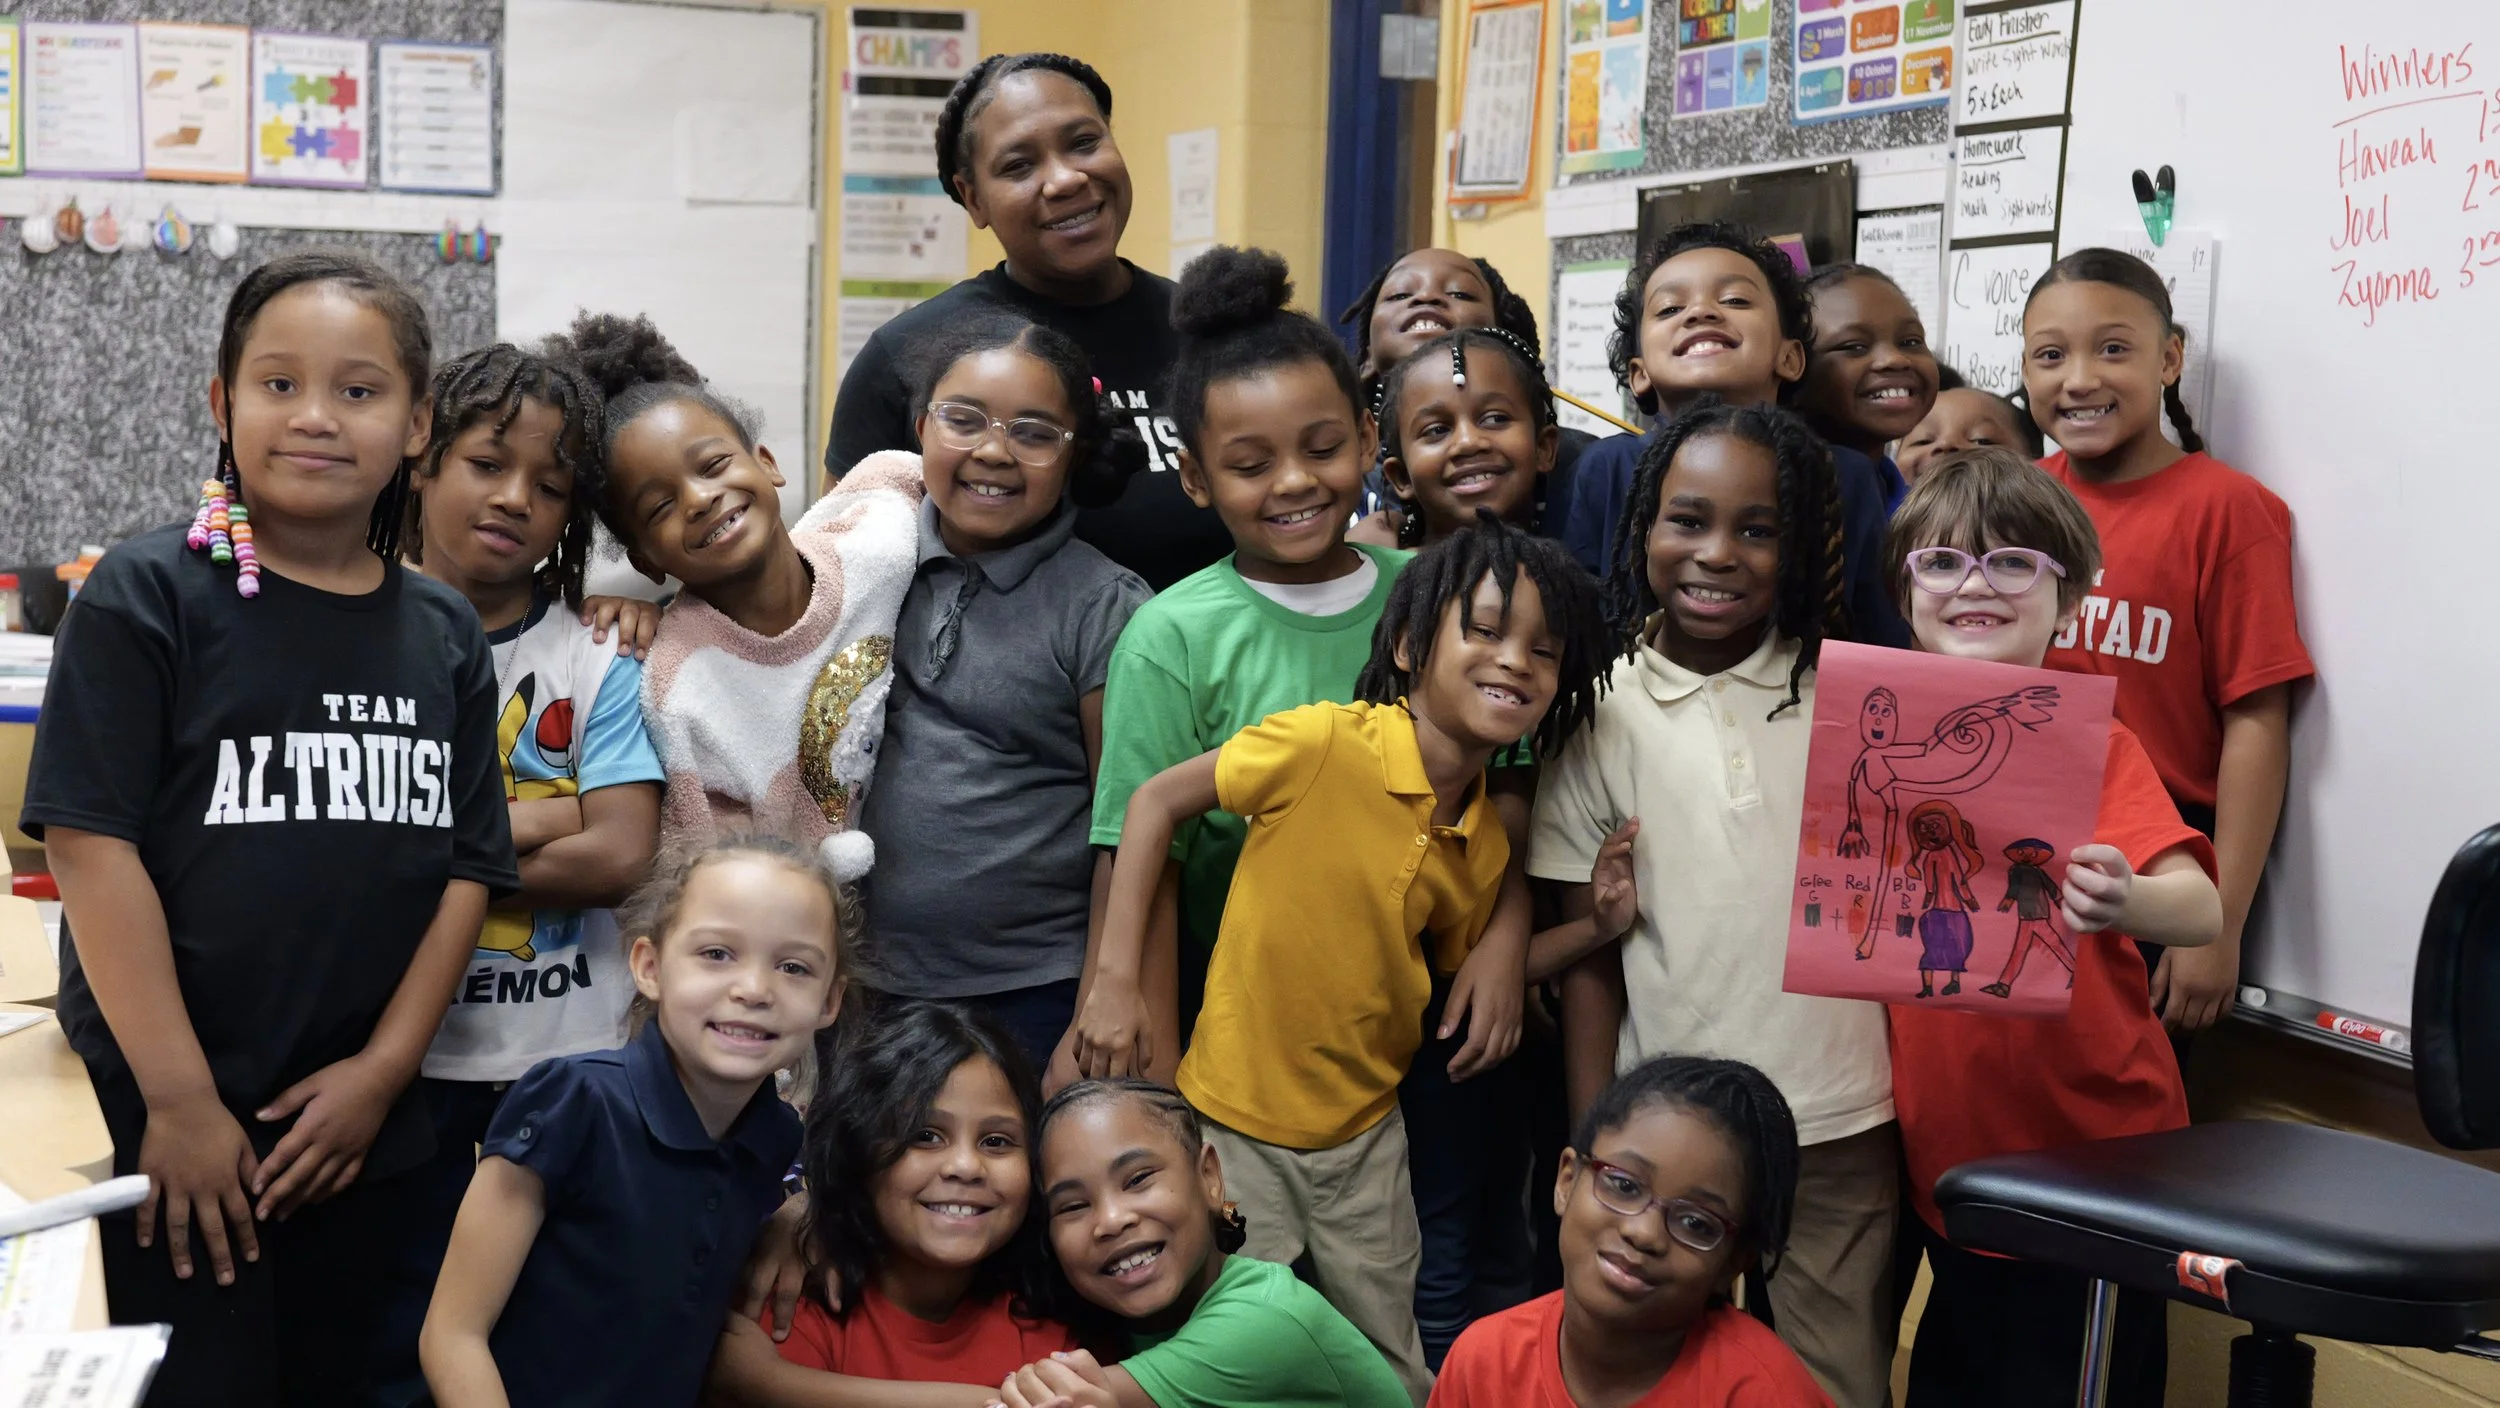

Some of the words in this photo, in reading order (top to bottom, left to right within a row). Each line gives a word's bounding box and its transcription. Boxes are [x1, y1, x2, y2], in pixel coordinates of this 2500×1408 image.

[1680, 13, 1735, 44] WEATHER
[1823, 24, 1844, 39] March
[1856, 33, 1894, 49] September
[1915, 22, 1953, 37] November
[857, 34, 961, 69] CHAMPS
[1906, 56, 1943, 70] December
[1865, 63, 1894, 77] October
[2340, 42, 2473, 102] Winners
[1806, 84, 1821, 97] April
[1963, 130, 2024, 160] Homework
[1961, 170, 2001, 194] Reading
[1960, 197, 1988, 217] Math
[2330, 193, 2389, 251] Joel
[1954, 252, 1971, 309] C
[2331, 260, 2439, 328] Zyonna
[1995, 308, 2023, 337] Leve
[1969, 352, 2007, 389] Raise
[1109, 389, 1149, 409] AM
[322, 693, 417, 726] TEAM
[1845, 875, 1871, 892] Red
[1809, 890, 1818, 902] G
[1853, 895, 1863, 908] R
[451, 953, 593, 1005] ÉMON
